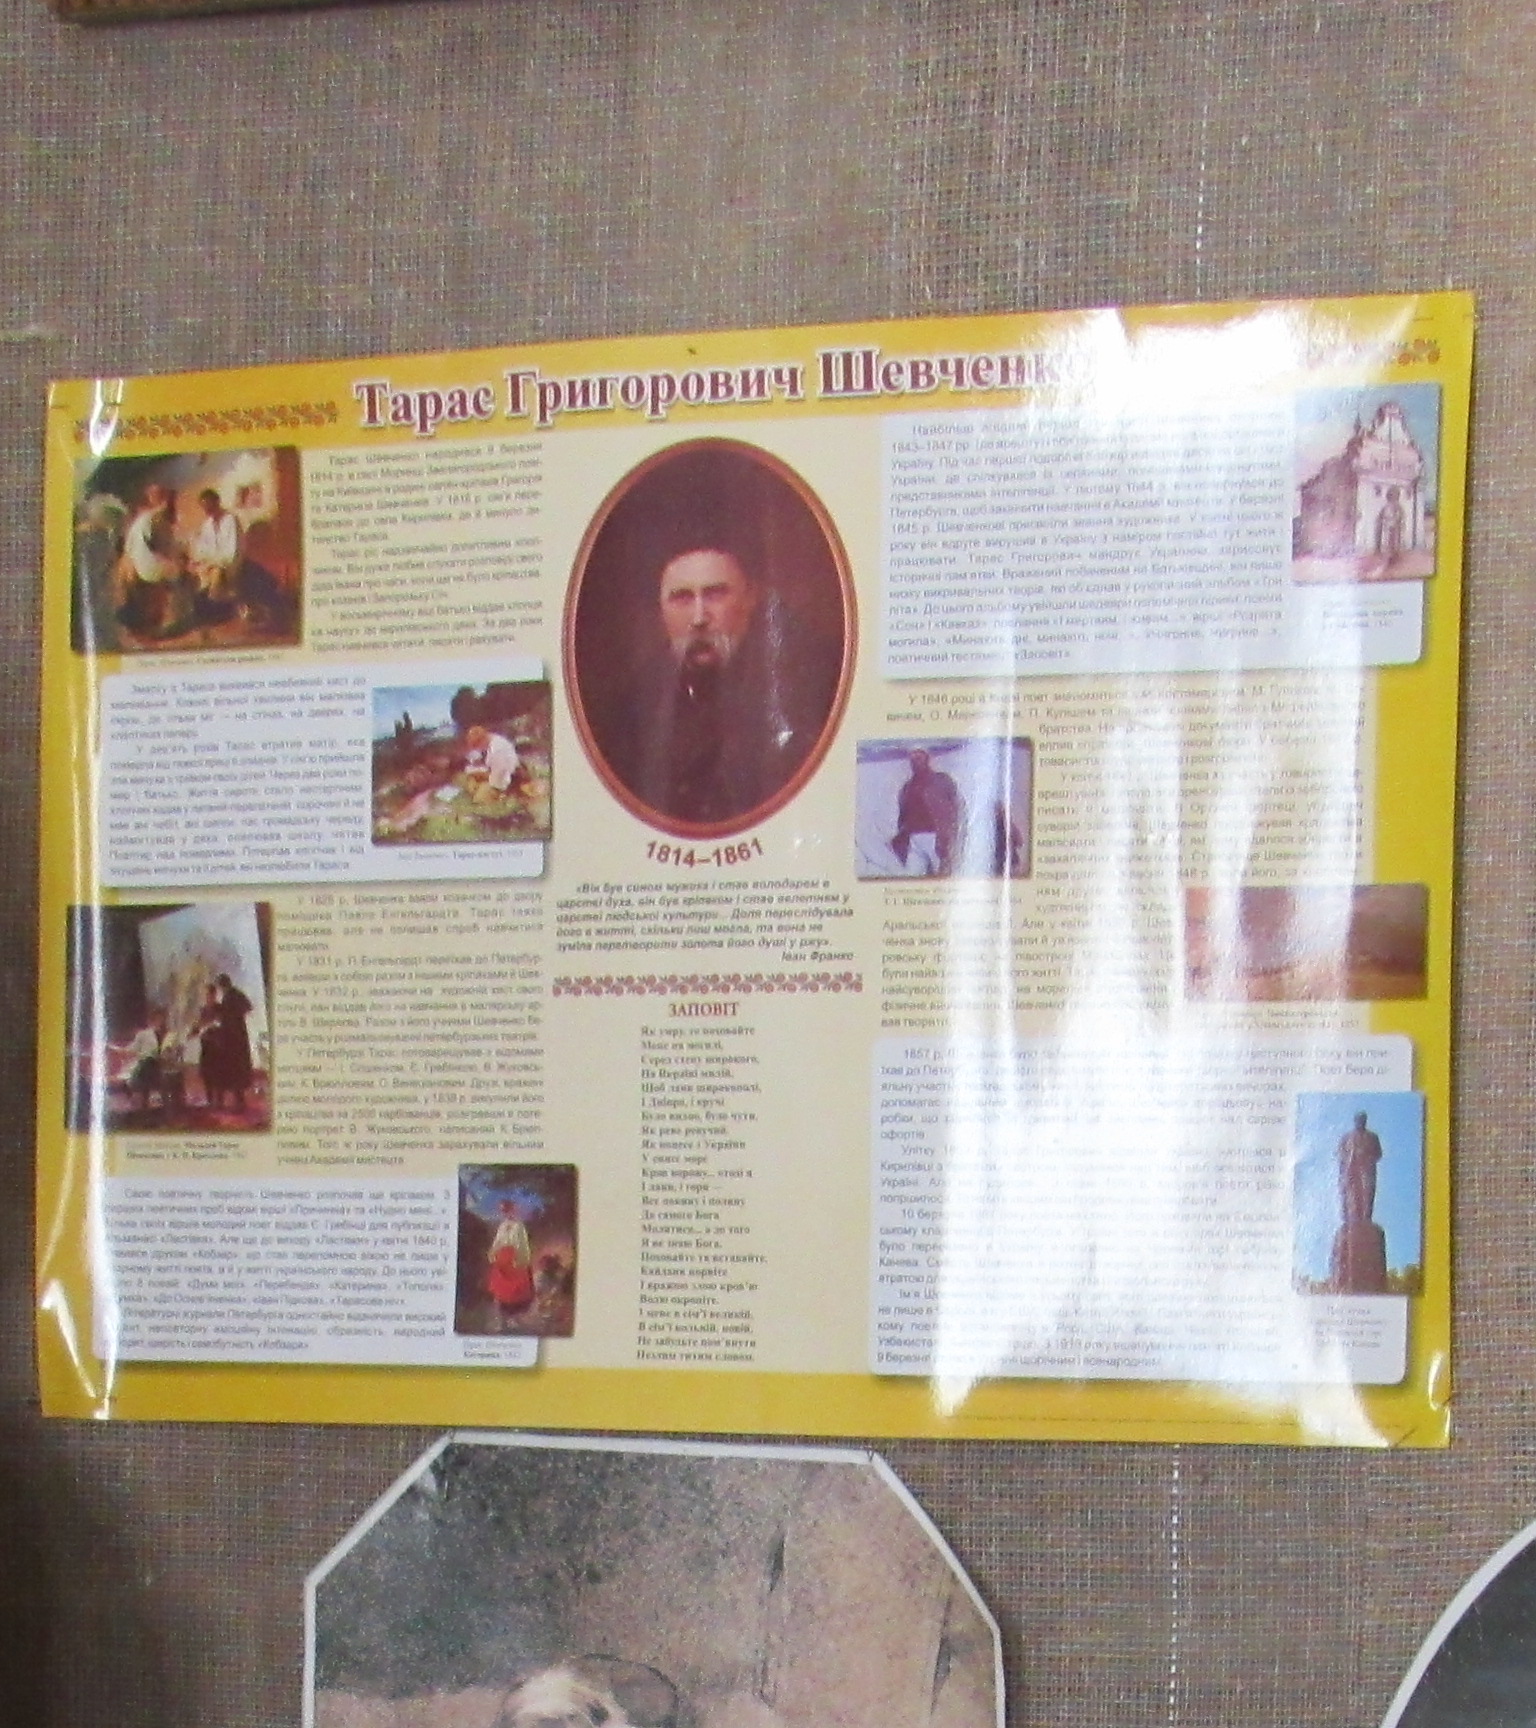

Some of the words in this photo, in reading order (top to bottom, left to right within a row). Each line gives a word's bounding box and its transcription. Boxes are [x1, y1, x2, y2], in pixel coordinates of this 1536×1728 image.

[354, 381, 495, 436] Тарас
[504, 364, 805, 430] Григорович
[817, 346, 1079, 399] Шевченк
[647, 838, 763, 868] 1814–1861
[669, 1001, 739, 1017] ЗАПОВІТ
